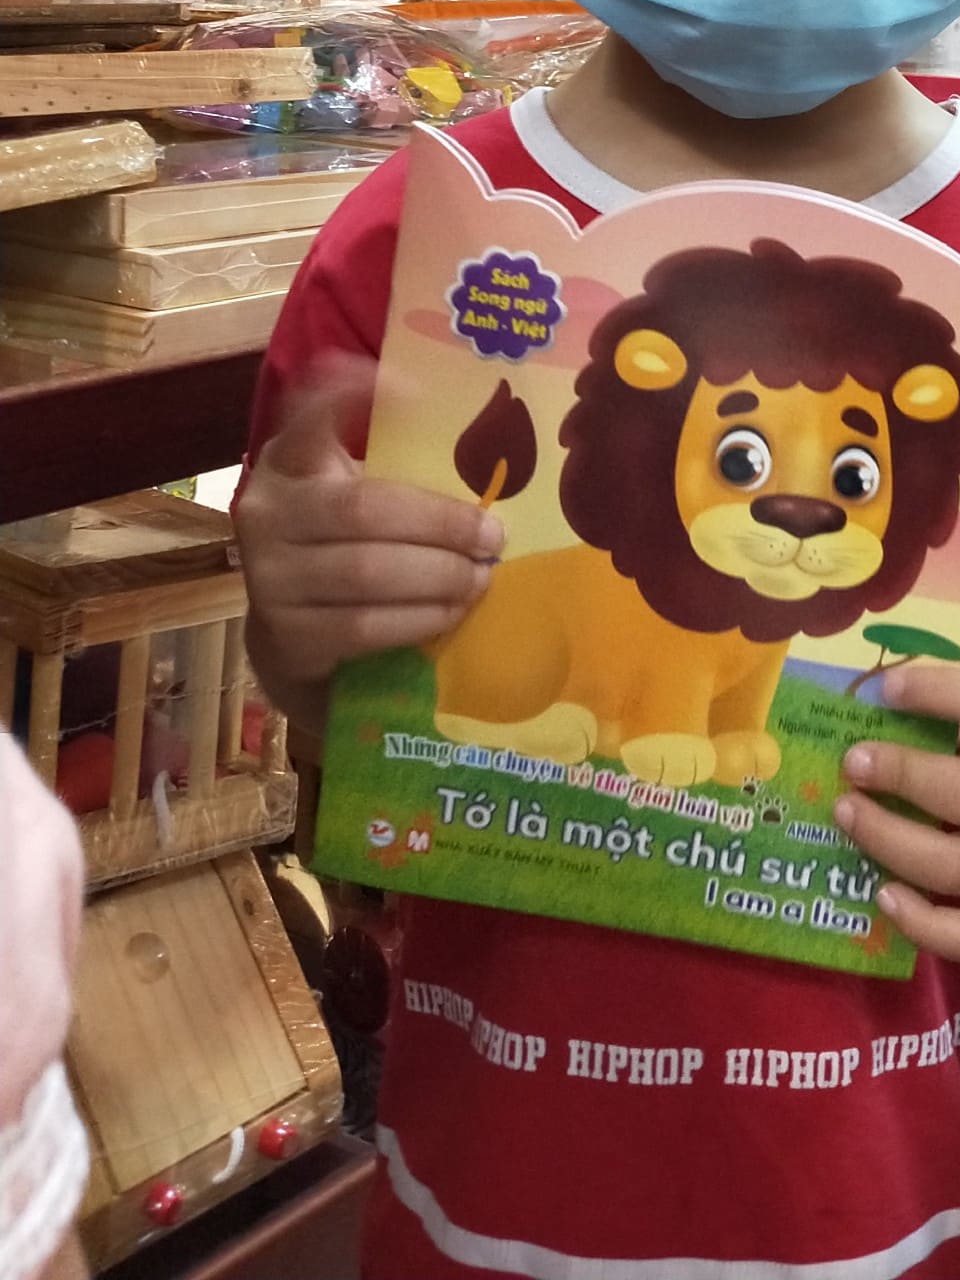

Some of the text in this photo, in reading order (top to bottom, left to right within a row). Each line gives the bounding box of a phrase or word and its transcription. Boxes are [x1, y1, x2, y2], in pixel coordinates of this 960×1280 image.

[468, 285, 511, 311] Song
[490, 267, 531, 291] Sách
[461, 309, 499, 331] Anh
[511, 316, 547, 341] Việt
[385, 732, 454, 767] Những
[492, 750, 566, 783] chuyện
[566, 761, 594, 787] về
[628, 782, 676, 810] giới
[674, 789, 719, 824] loài
[719, 803, 754, 833] vật
[437, 786, 880, 903] Tớ là một chú sư tử
[704, 877, 872, 937] I am a lion
[403, 977, 475, 1032] HIPHOP
[566, 1037, 705, 1087] HIPHOP
[723, 1046, 861, 1090] HIPHOP
[870, 1019, 954, 1078] HIPHO
